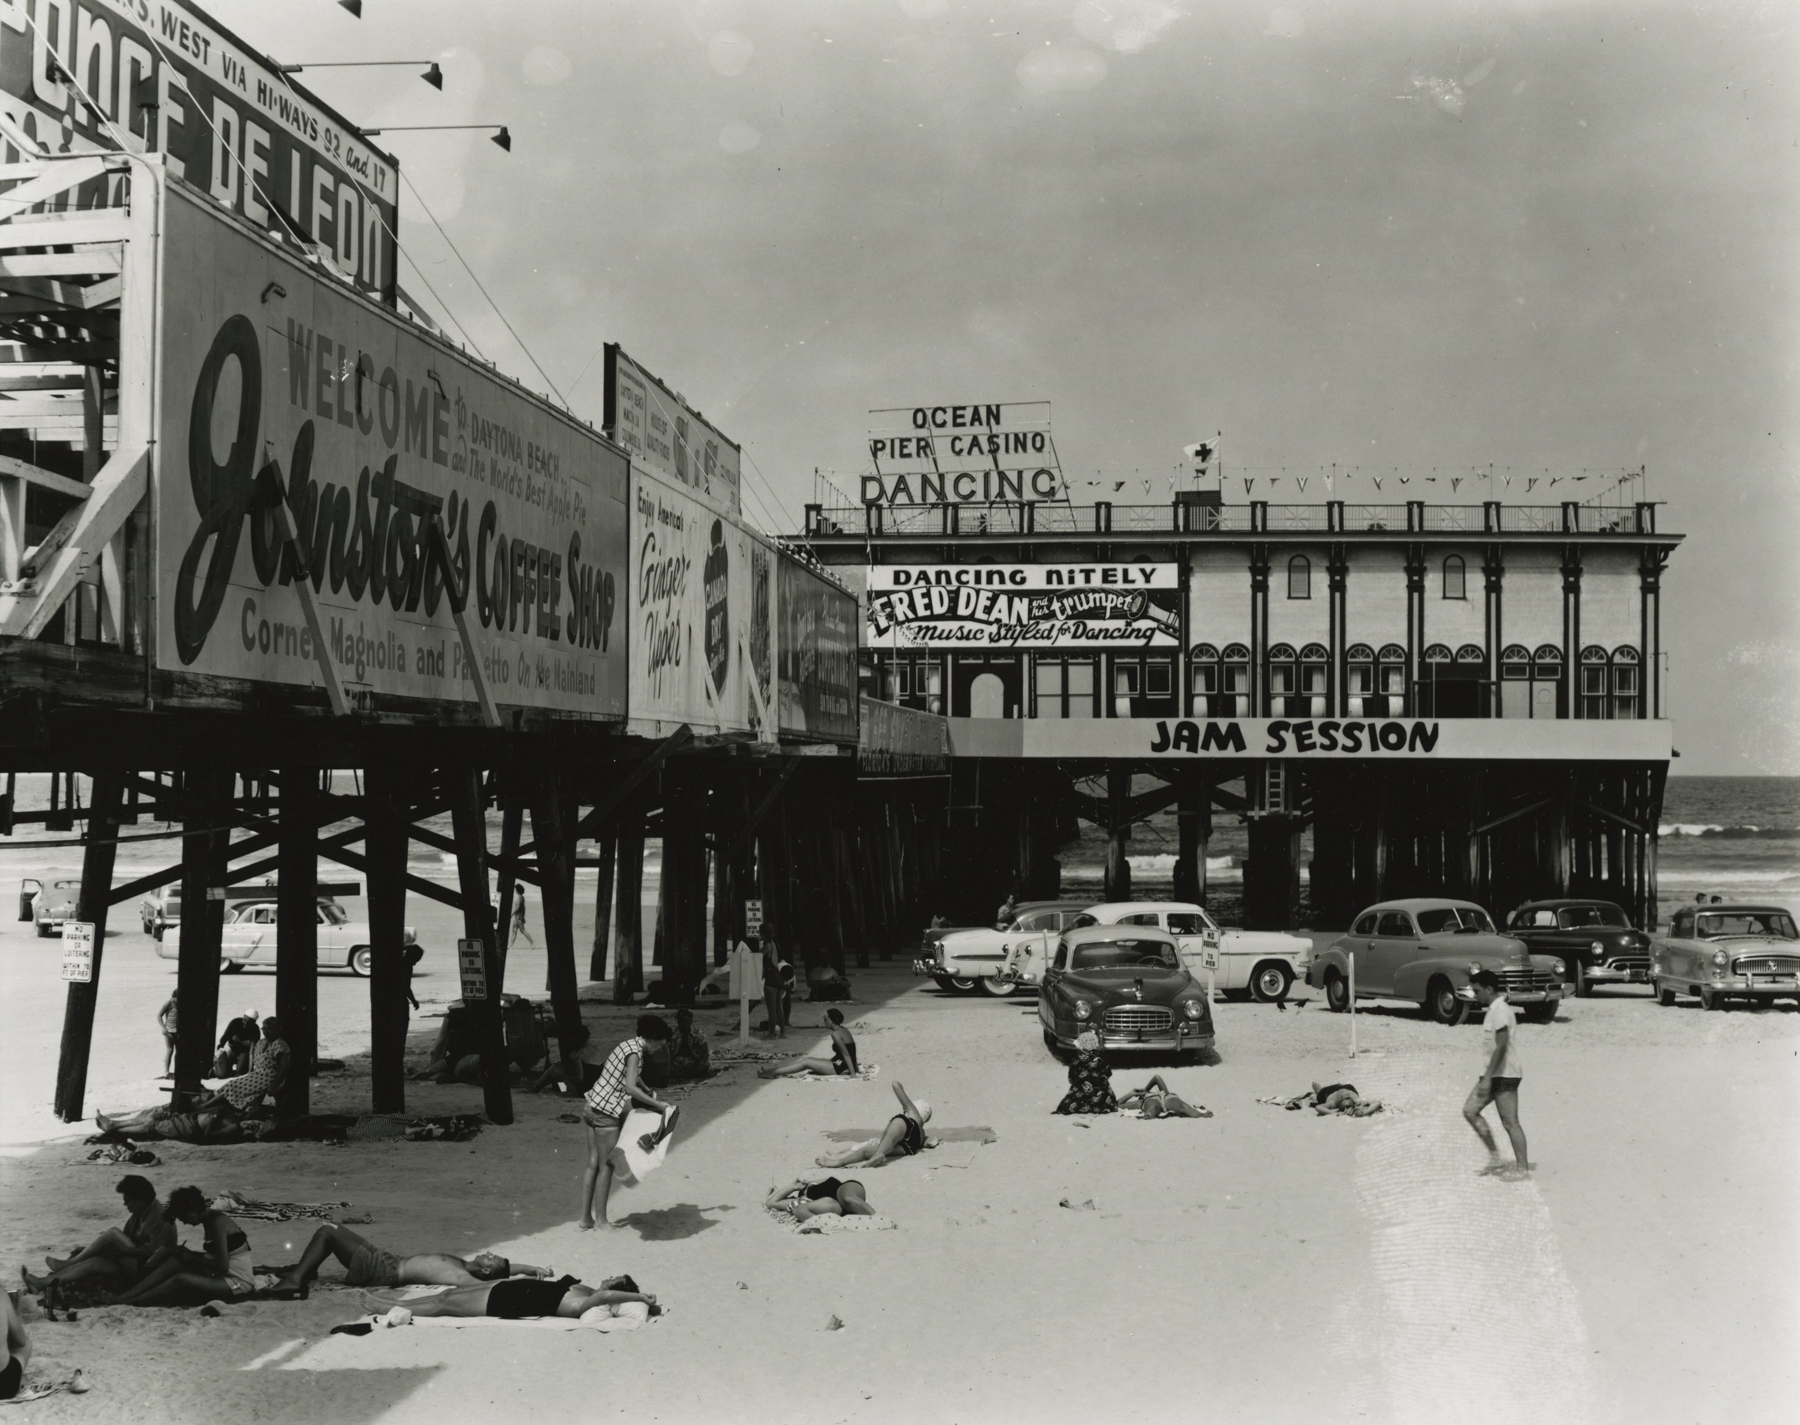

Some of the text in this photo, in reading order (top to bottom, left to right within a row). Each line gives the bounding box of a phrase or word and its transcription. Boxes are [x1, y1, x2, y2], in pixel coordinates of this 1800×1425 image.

[160, 5, 211, 66] WEST
[222, 51, 248, 93] VIA
[324, 127, 341, 160] 92
[373, 162, 386, 193] 17
[210, 95, 271, 229] DE
[287, 316, 450, 468] WELCOME
[471, 411, 523, 467] DAYTONA
[913, 404, 1001, 429] OCEAN
[872, 432, 1045, 459] PIER CASINO
[469, 448, 486, 483] The
[490, 456, 523, 500] World's
[525, 473, 546, 513] Best
[547, 485, 571, 528] Apple
[573, 490, 586, 527] Pie
[861, 469, 1056, 504] DANCING
[638, 486, 684, 533] Enjoy America's
[872, 586, 949, 632] FRED
[956, 586, 1029, 626] DEAN
[1053, 621, 1072, 645] for
[1071, 619, 1157, 647] Dancing
[330, 616, 406, 682] Magnolia
[416, 639, 446, 679] and
[518, 651, 530, 690] On
[554, 658, 596, 696] Mainland
[644, 610, 682, 700] Upper
[1150, 719, 1439, 754] JAM SESSION
[67, 933, 90, 941] PARKING
[467, 942, 473, 950] NO
[1204, 940, 1218, 949] PARKING
[1207, 932, 1214, 940] NO
[64, 950, 90, 958] LOITERING
